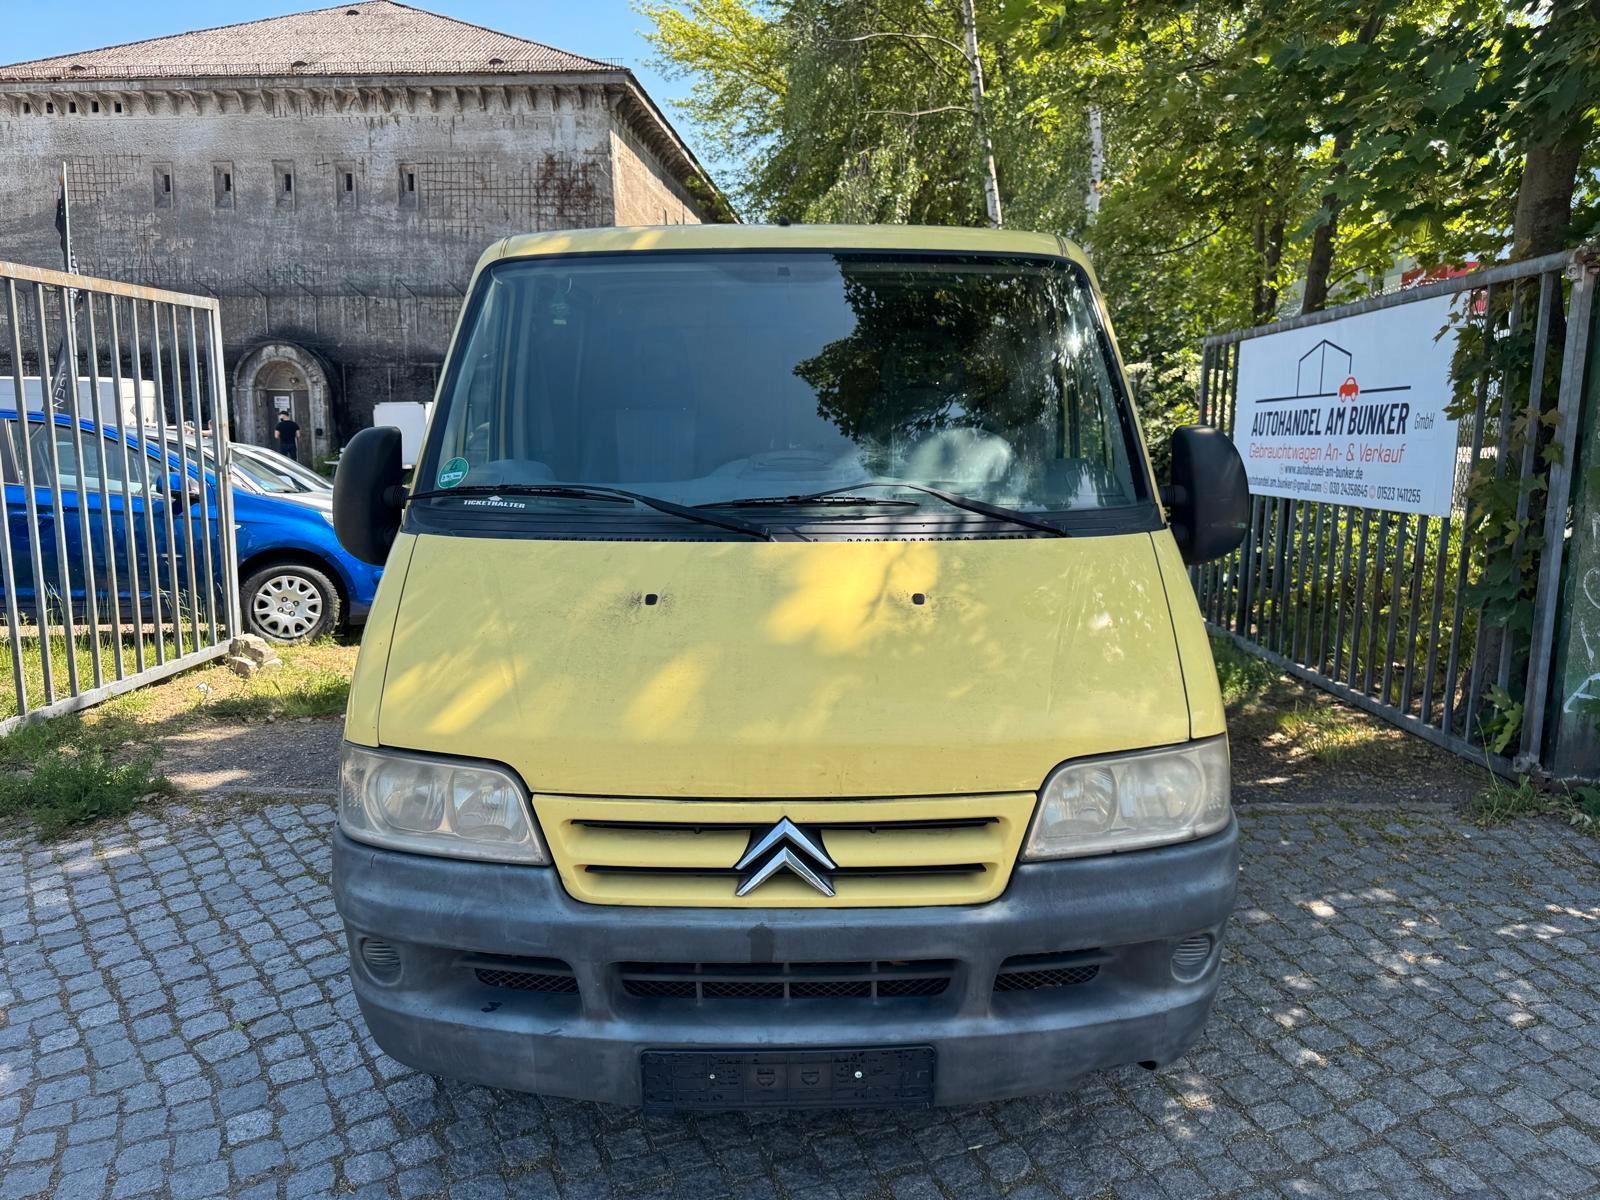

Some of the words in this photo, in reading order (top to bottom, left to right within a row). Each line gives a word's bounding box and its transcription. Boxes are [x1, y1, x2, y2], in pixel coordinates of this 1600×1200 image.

[1251, 408, 1321, 436] AUTOHANDEL
[1325, 407, 1346, 435] AM
[1347, 403, 1409, 436] BUNKER
[1414, 412, 1435, 430] GmbH
[1249, 442, 1321, 464] Gebrauchtwagen
[1325, 442, 1342, 461] An-
[1346, 443, 1354, 461] &
[1360, 443, 1406, 463] Verkauf
[1284, 464, 1363, 480] www.autohandel-am-bunker.de
[1248, 476, 1322, 493] utohandel.am.bunker@gmail.com
[1329, 481, 1340, 494] 030
[1377, 486, 1395, 501] 01523
[463, 500, 525, 509] TICKETHALTER
